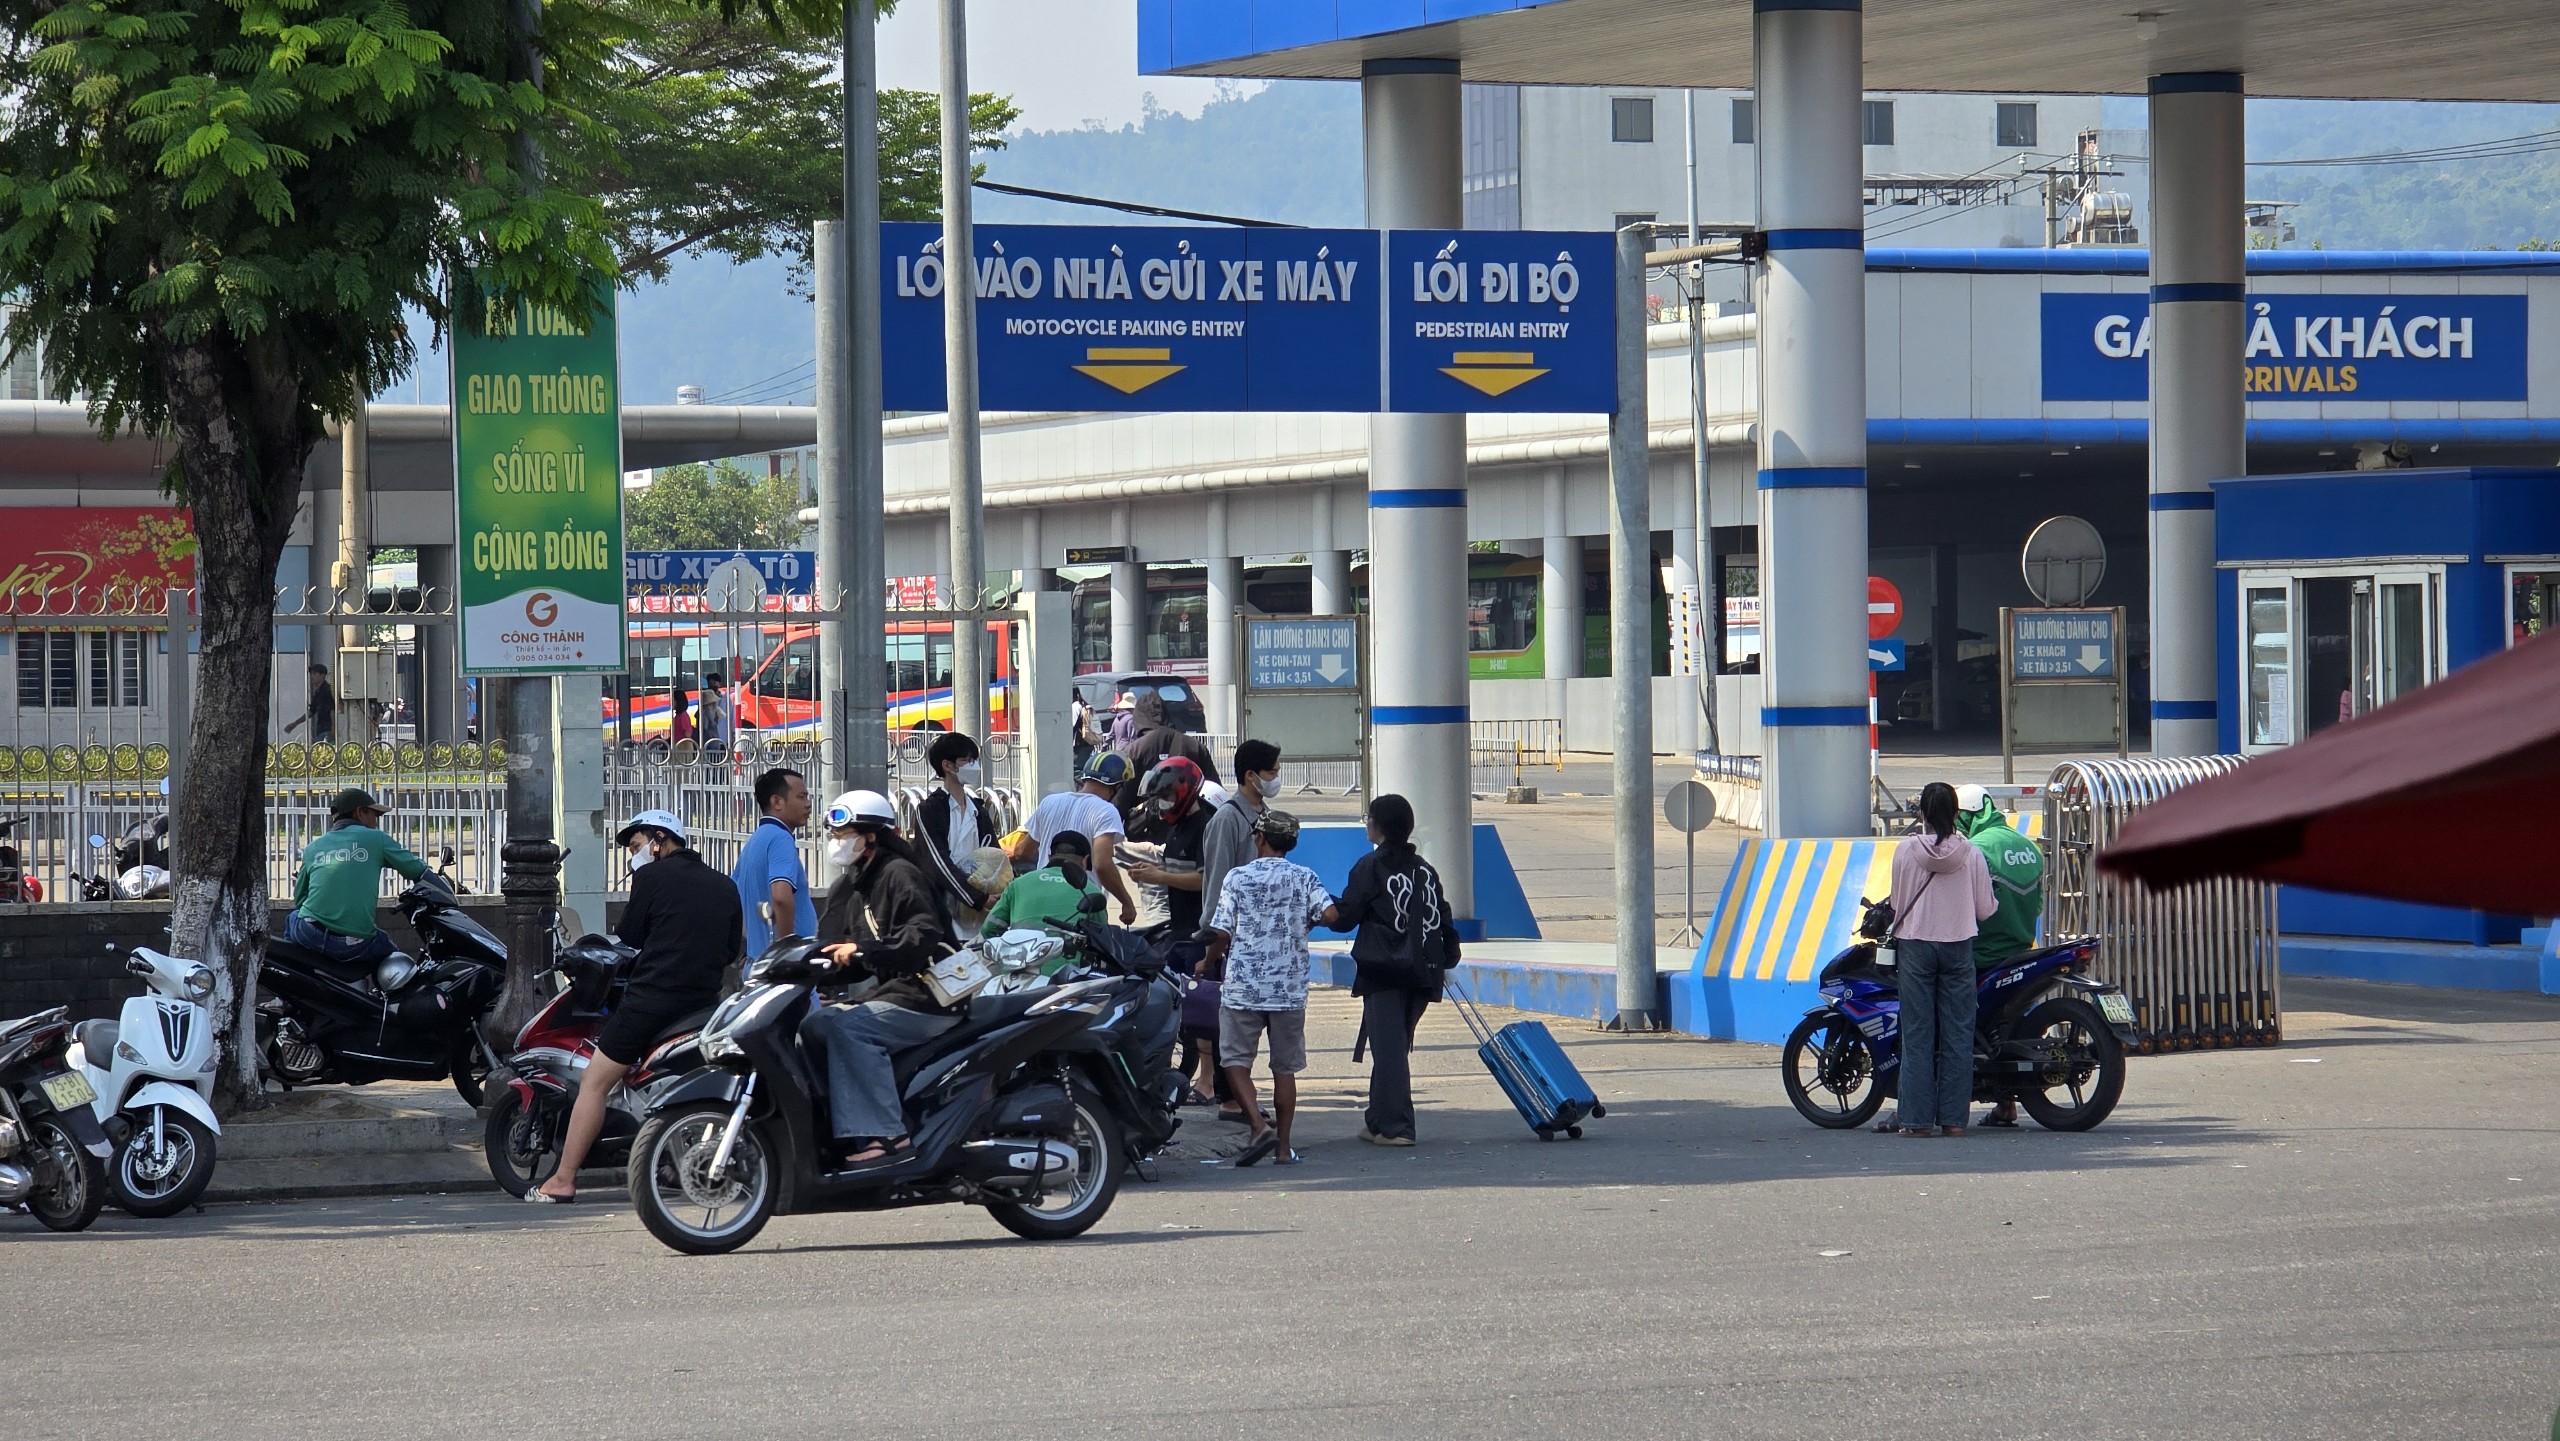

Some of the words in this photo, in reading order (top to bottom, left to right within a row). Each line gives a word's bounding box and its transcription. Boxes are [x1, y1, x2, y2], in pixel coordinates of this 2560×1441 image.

[897, 237, 944, 297] LỐ
[973, 240, 1042, 298] VÀO
[1054, 244, 1133, 300] NHÀ
[1140, 240, 1206, 300] GỬI
[1218, 260, 1264, 301] XE
[1276, 246, 1358, 301] MÁY
[1414, 239, 1467, 302] LỐI
[1481, 262, 1519, 303] ĐI
[1528, 251, 1580, 313] BỘ
[1006, 318, 1117, 336] MOTOCYCLE
[1121, 319, 1187, 336] PAKING
[1192, 320, 1246, 337] ENTRY
[1416, 321, 1514, 338] PEDESTRIAN
[1520, 322, 1569, 338] ENTRY
[2295, 306, 2473, 359] KHÁCH
[468, 374, 522, 414] GIAO
[529, 366, 606, 414] THÔNG
[2245, 366, 2358, 392] RRIVALS
[492, 438, 557, 493] SỐNG
[563, 445, 586, 492] VÌ
[473, 523, 537, 580] CỘNG
[544, 517, 608, 571] ĐỒNG
[760, 553, 800, 580] TÔ
[501, 630, 540, 643] CÔNG
[543, 629, 585, 643] THÀNH
[1254, 626, 1271, 649] LÀN
[1274, 625, 1303, 649] ĐƯỜNG
[1306, 625, 1330, 648] DÀNH
[1332, 628, 1350, 648] CHO
[2019, 617, 2035, 639] LÀN
[2037, 617, 2065, 639] ĐƯỜNG
[2066, 617, 2089, 639] DÀNH
[2091, 620, 2108, 639] CHO
[1272, 655, 1311, 667] CON-TAXI
[2037, 643, 2066, 657] KHÁCH
[1272, 669, 1285, 684] TẢI
[2035, 659, 2047, 673] TẢI
[312, 842, 369, 868] Grab
[2004, 847, 2037, 866] Grab
[1039, 873, 1065, 883] Gra
[1995, 972, 2024, 989] 150
